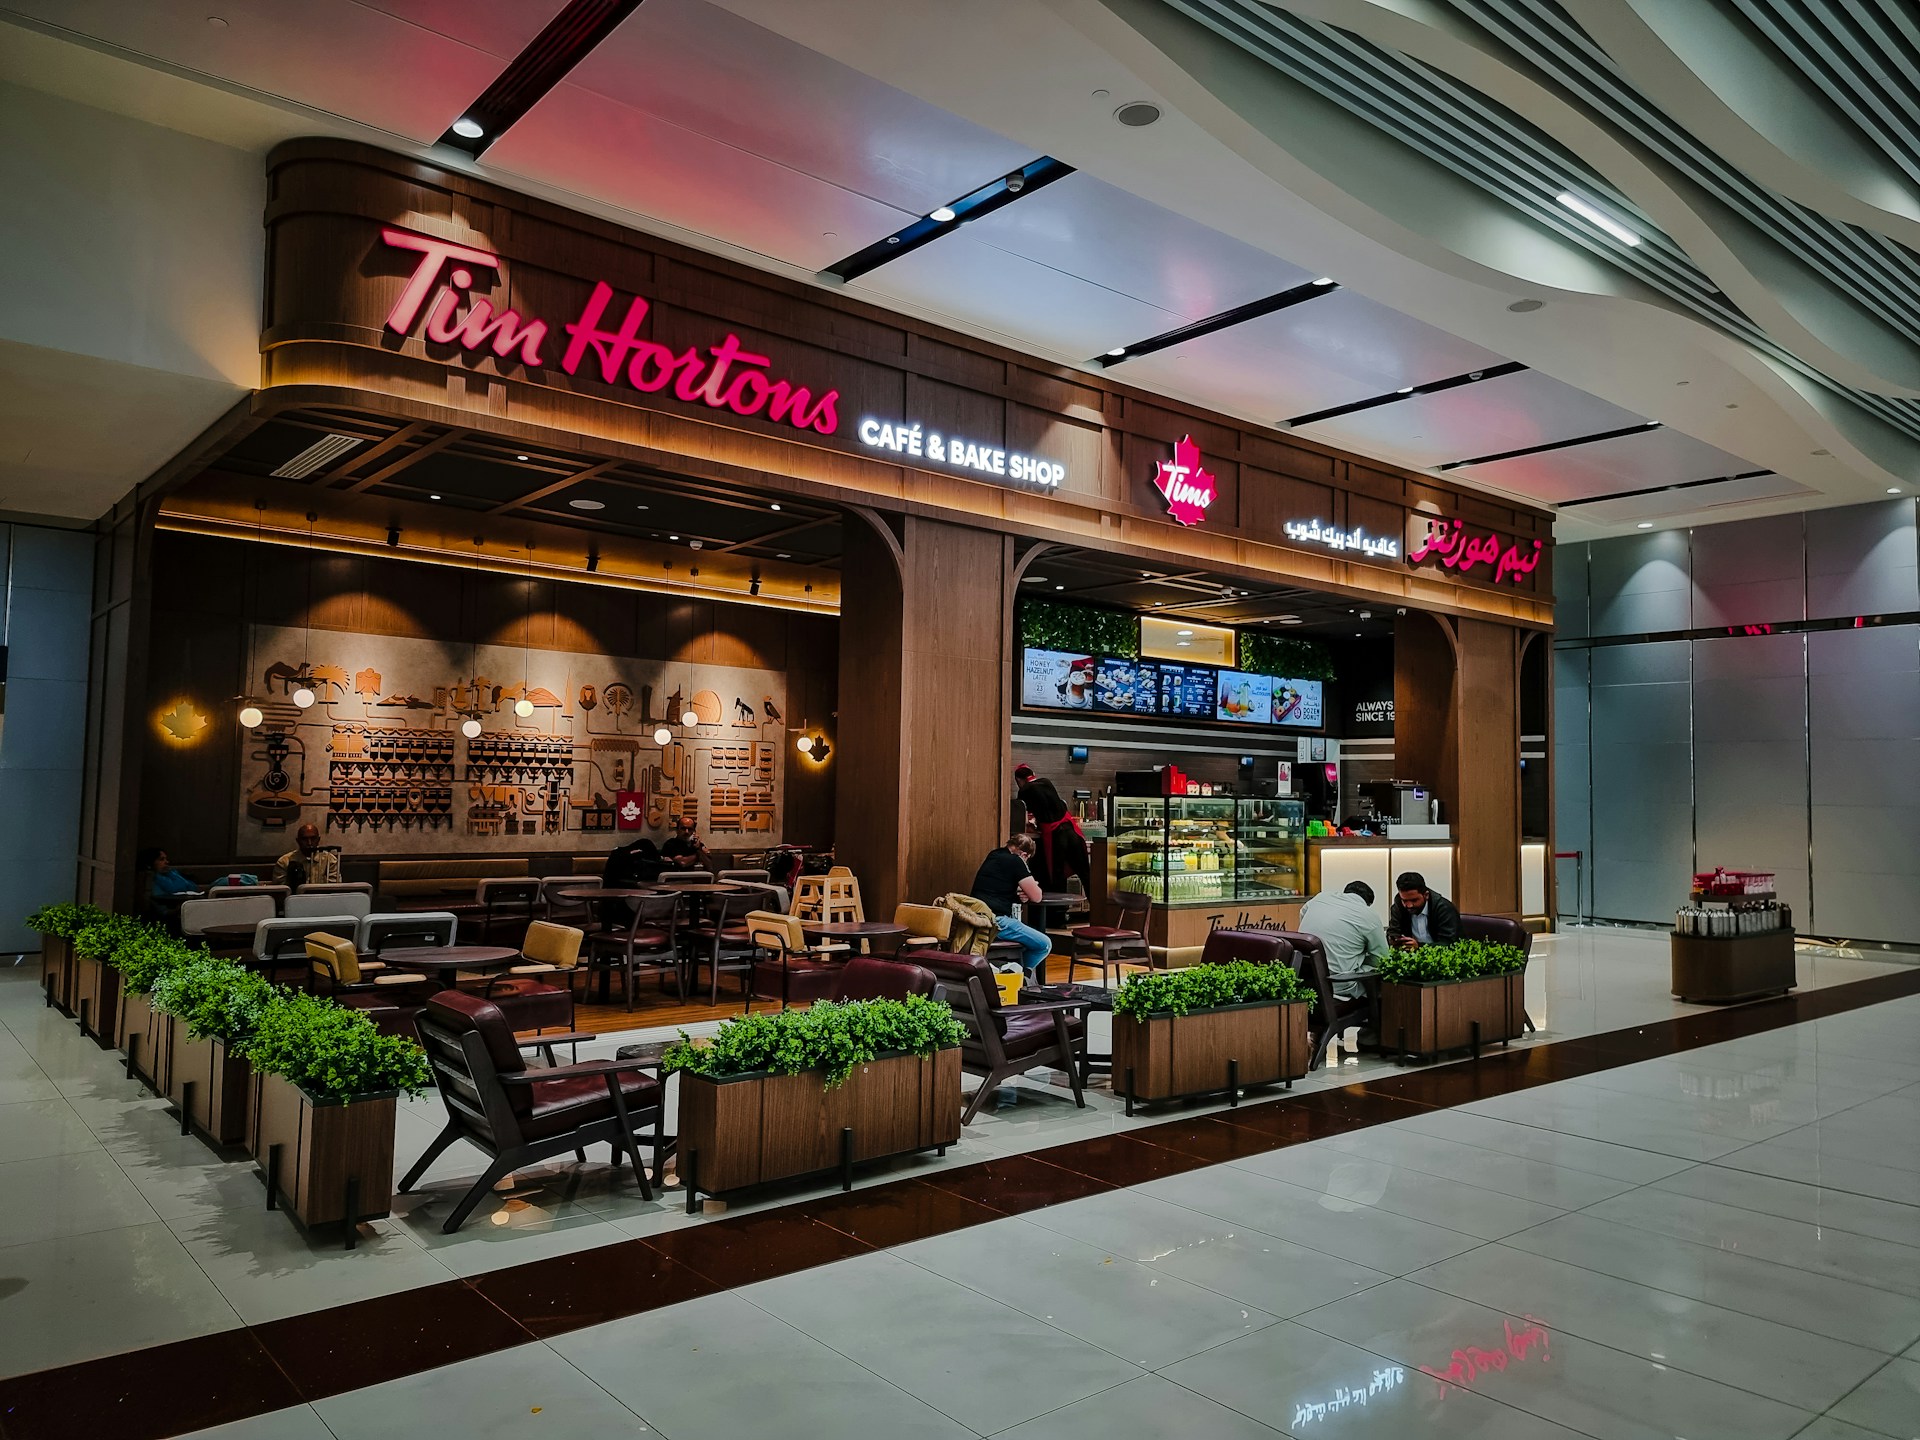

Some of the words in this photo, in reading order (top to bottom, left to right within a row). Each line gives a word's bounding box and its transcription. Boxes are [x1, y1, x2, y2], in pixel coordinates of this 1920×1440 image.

[383, 230, 545, 367] Tim
[560, 280, 842, 437] Hortons
[860, 420, 922, 456] CAFÉ
[927, 434, 946, 462] &
[948, 440, 1006, 475] BAKE
[1009, 454, 1065, 487] SHOP
[1161, 464, 1210, 508] Tims
[1355, 711, 1384, 722] SINCE
[1356, 700, 1394, 711] ALWAYS
